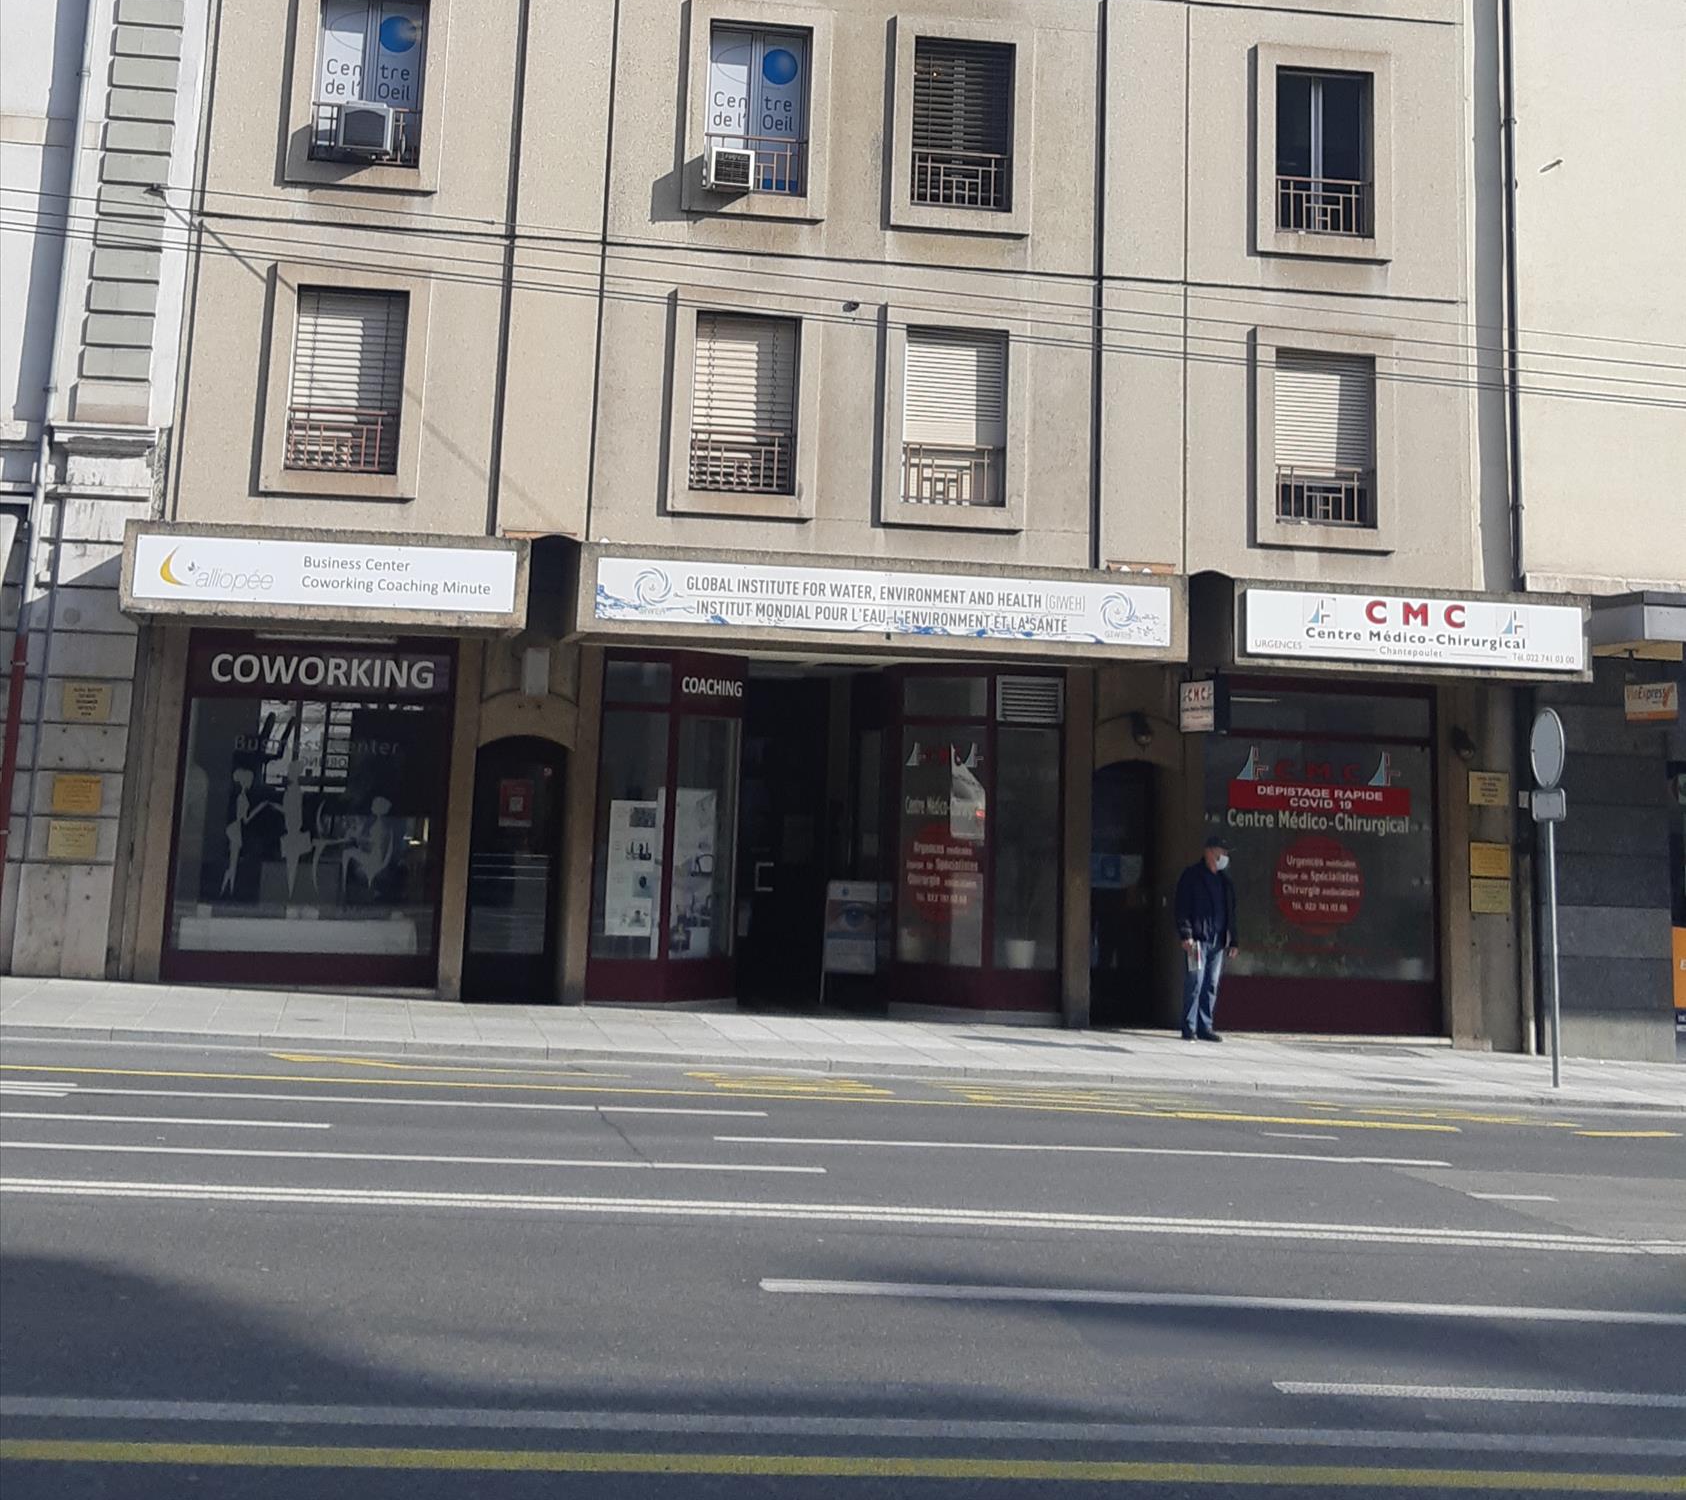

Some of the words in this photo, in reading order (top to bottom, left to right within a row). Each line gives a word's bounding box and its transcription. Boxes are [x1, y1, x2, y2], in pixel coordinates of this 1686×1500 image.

[325, 78, 346, 95] de
[713, 111, 733, 127] de
[303, 555, 362, 571] Business
[365, 558, 411, 572] Center
[301, 575, 374, 593] Coworking
[377, 578, 439, 596] Coaching
[442, 581, 491, 595] Minute
[686, 576, 734, 593] GLOBAL
[736, 579, 799, 596] INSTITUTE
[802, 582, 826, 597] FOR
[829, 583, 876, 601] WATER,
[880, 586, 966, 605] ENVIRONMENT
[969, 591, 995, 607] AND
[997, 592, 1042, 609] HEALTH
[696, 600, 753, 617] INSTITUT
[755, 602, 812, 620] MONDIAL
[815, 604, 848, 622] POUR
[994, 614, 1009, 629] ET
[1011, 616, 1026, 630] LA
[1254, 639, 1303, 650] URGENCES
[1305, 626, 1362, 642] Centre
[1368, 629, 1527, 651] Médico-Chirurgical
[1379, 645, 1443, 659] Chantepoulet
[1526, 653, 1539, 662] 022
[211, 653, 435, 689] COWORKING
[682, 675, 744, 698] COACHING
[234, 732, 323, 752] Busnss
[1257, 784, 1330, 799] DÉPISTAGE
[1334, 789, 1383, 802] RAPIDE
[1289, 797, 1334, 808] COVID
[1339, 801, 1353, 810] 19
[1227, 808, 1274, 828] Centre
[1278, 811, 1409, 836] Médico-Chirurgical
